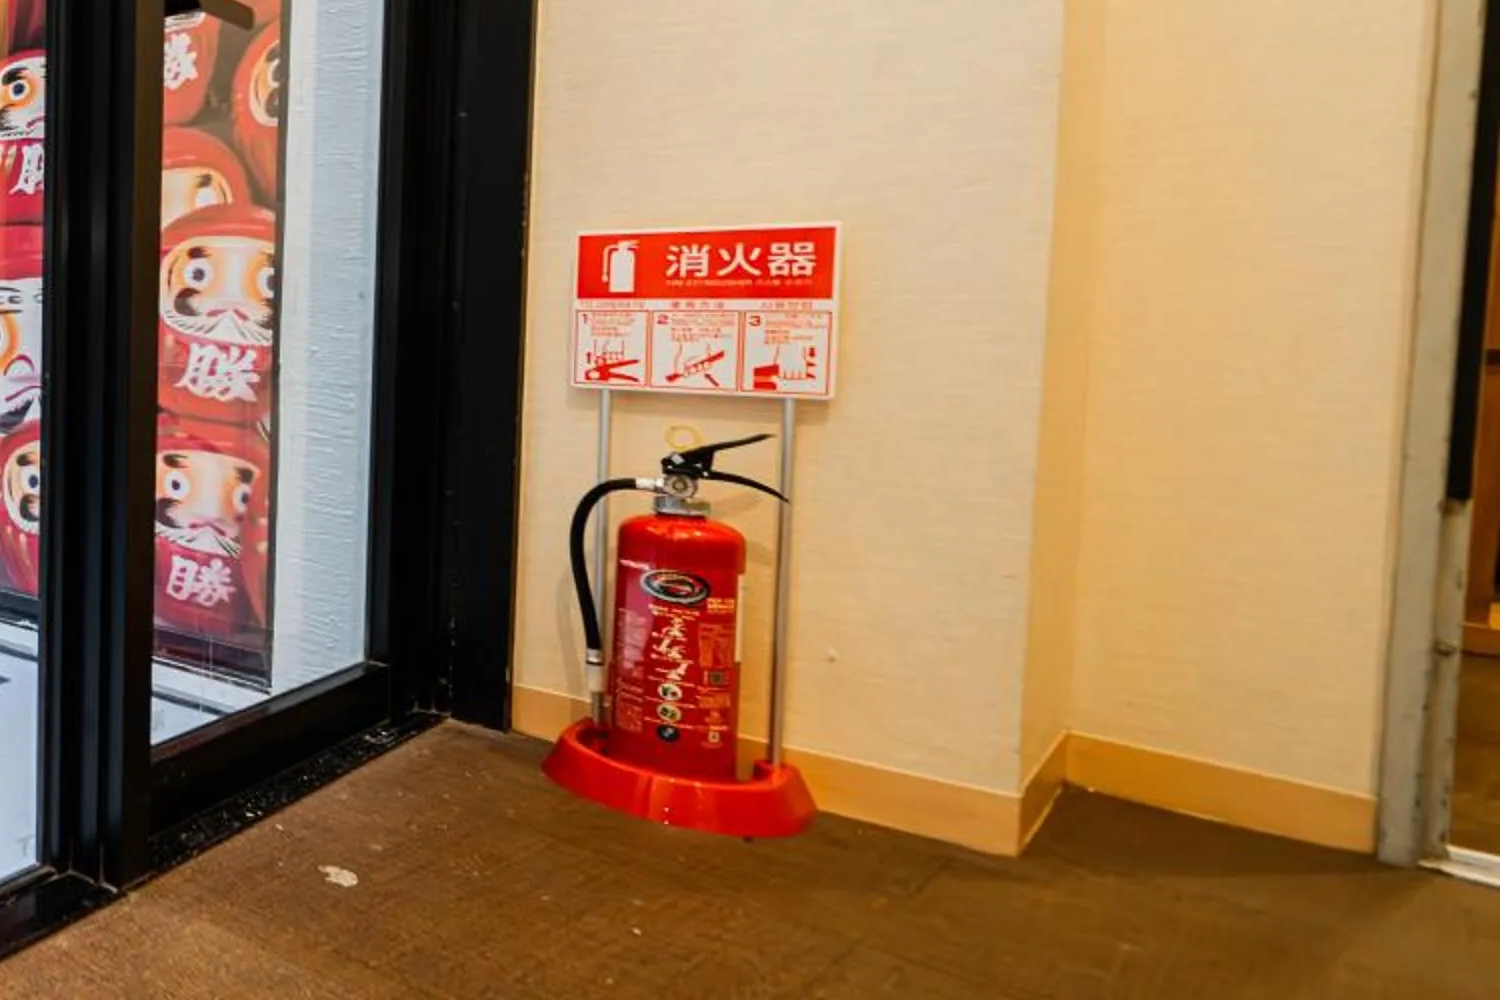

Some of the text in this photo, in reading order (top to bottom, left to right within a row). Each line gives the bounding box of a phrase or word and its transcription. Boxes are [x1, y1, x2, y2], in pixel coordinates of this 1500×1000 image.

[665, 241, 817, 278] 消火器
[748, 314, 761, 327] 3
[172, 343, 261, 402] 勝
[165, 553, 237, 608] 勝
